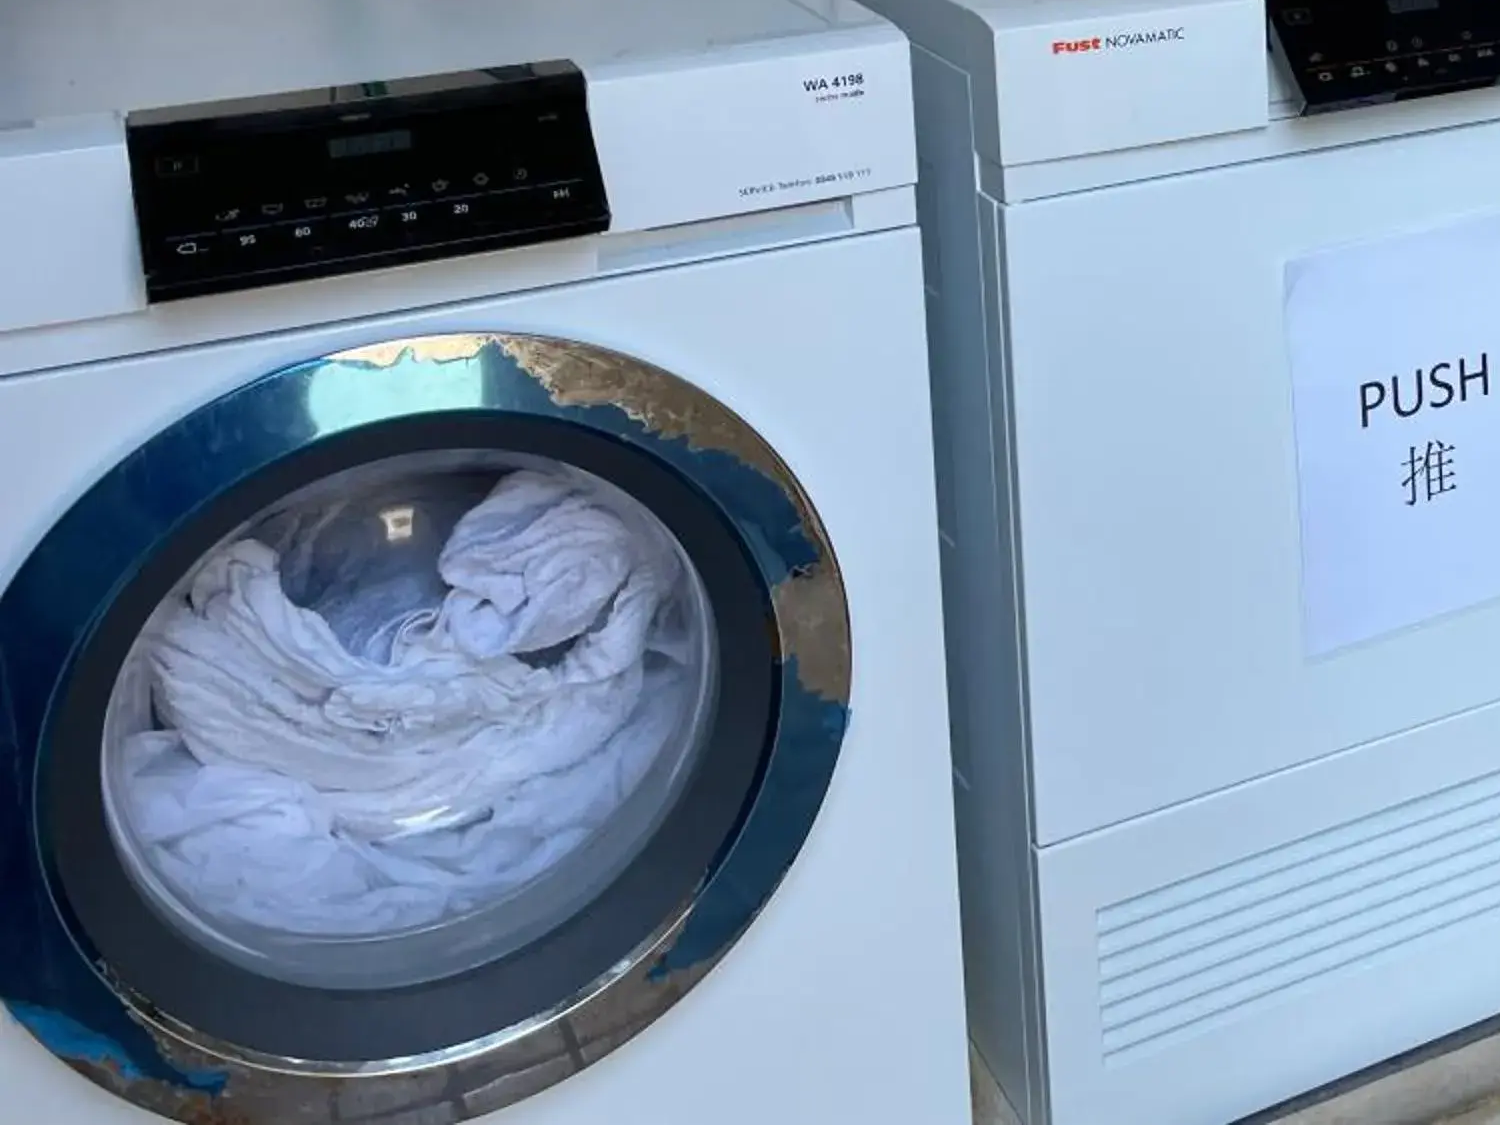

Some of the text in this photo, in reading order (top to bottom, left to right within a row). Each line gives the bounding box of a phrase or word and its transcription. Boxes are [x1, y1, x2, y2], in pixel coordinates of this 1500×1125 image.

[1105, 26, 1185, 49] NOVAMATIC
[803, 72, 865, 92] WA 4198
[401, 211, 418, 222] 30
[453, 203, 470, 214] 20
[1360, 352, 1489, 428] PUSH
[1400, 439, 1457, 506] 推
